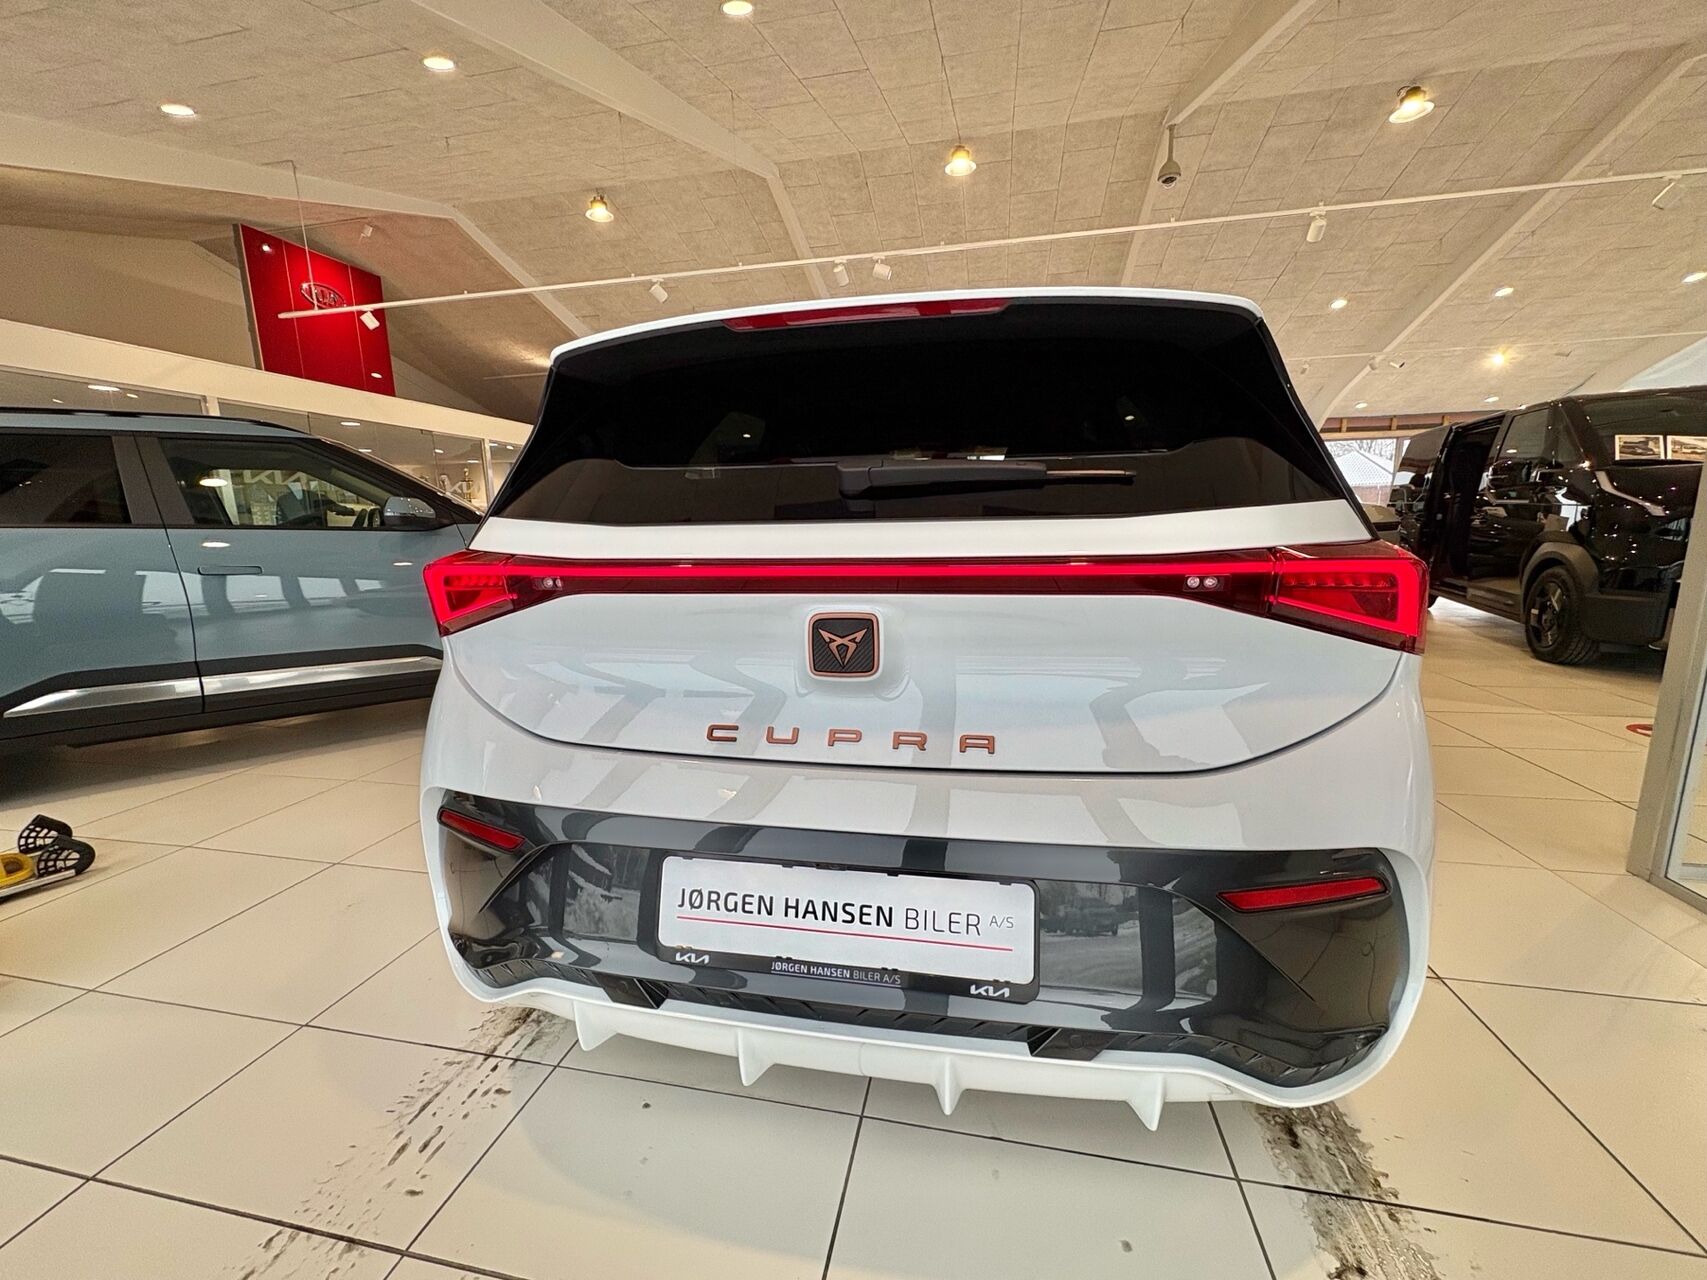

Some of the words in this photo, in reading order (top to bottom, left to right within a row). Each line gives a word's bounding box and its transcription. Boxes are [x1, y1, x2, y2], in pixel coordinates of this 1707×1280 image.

[706, 723, 996, 755] CUPRA
[677, 887, 774, 916] JØRGEN
[784, 897, 893, 927] HANSEN
[904, 907, 981, 936] BILER
[989, 915, 1014, 929] A/S
[770, 961, 808, 974] JØRGEN
[810, 965, 850, 979] HANSEN
[852, 970, 881, 982] BILER
[882, 973, 901, 985] A/S
